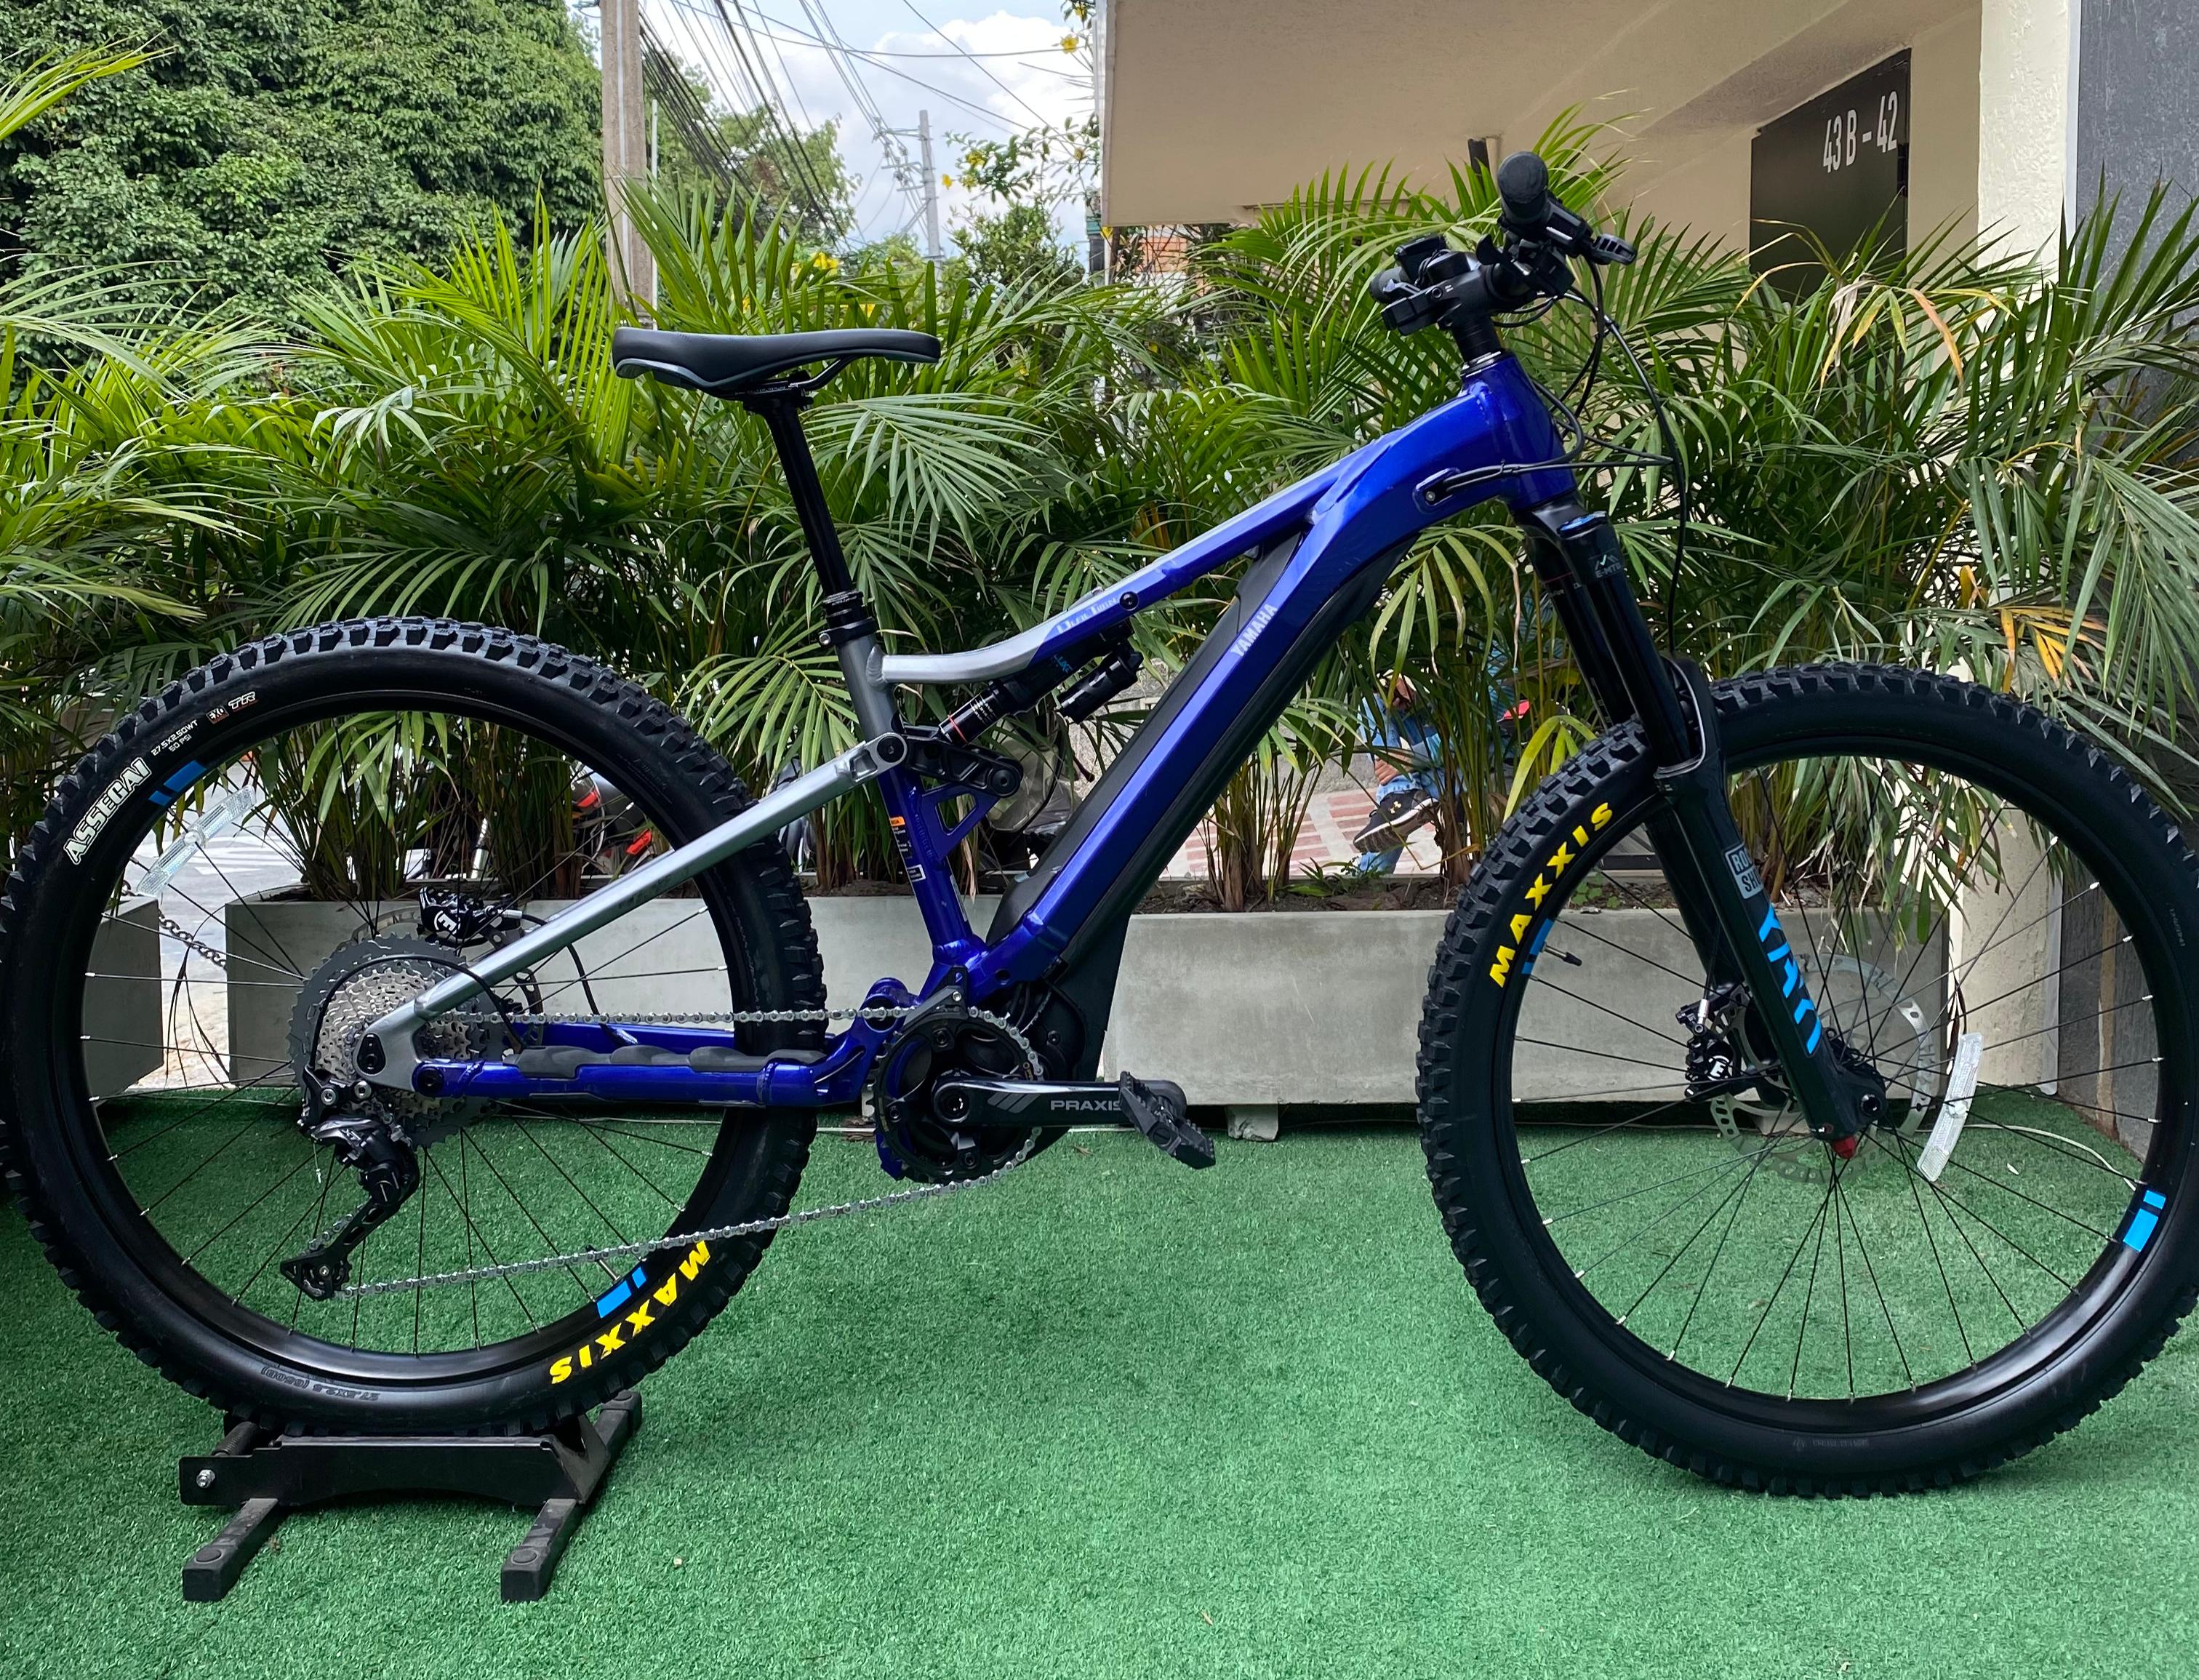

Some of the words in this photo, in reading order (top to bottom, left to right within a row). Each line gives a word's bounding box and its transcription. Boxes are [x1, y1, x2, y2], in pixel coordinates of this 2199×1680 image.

[1823, 115, 1842, 172] 43
[1846, 109, 1857, 166] B
[1877, 91, 1898, 153] 42
[1230, 604, 1278, 657] YAMAHA
[228, 691, 256, 710] TR
[151, 719, 198, 756] 27.5X2.50WT
[168, 742, 181, 752] 50
[179, 734, 192, 745] PSI
[63, 757, 152, 865] ASSEGAI
[1489, 802, 1613, 988] MAXXIS
[1051, 1100, 1121, 1111] PRAXIS
[549, 1239, 711, 1385] MAXXIS
